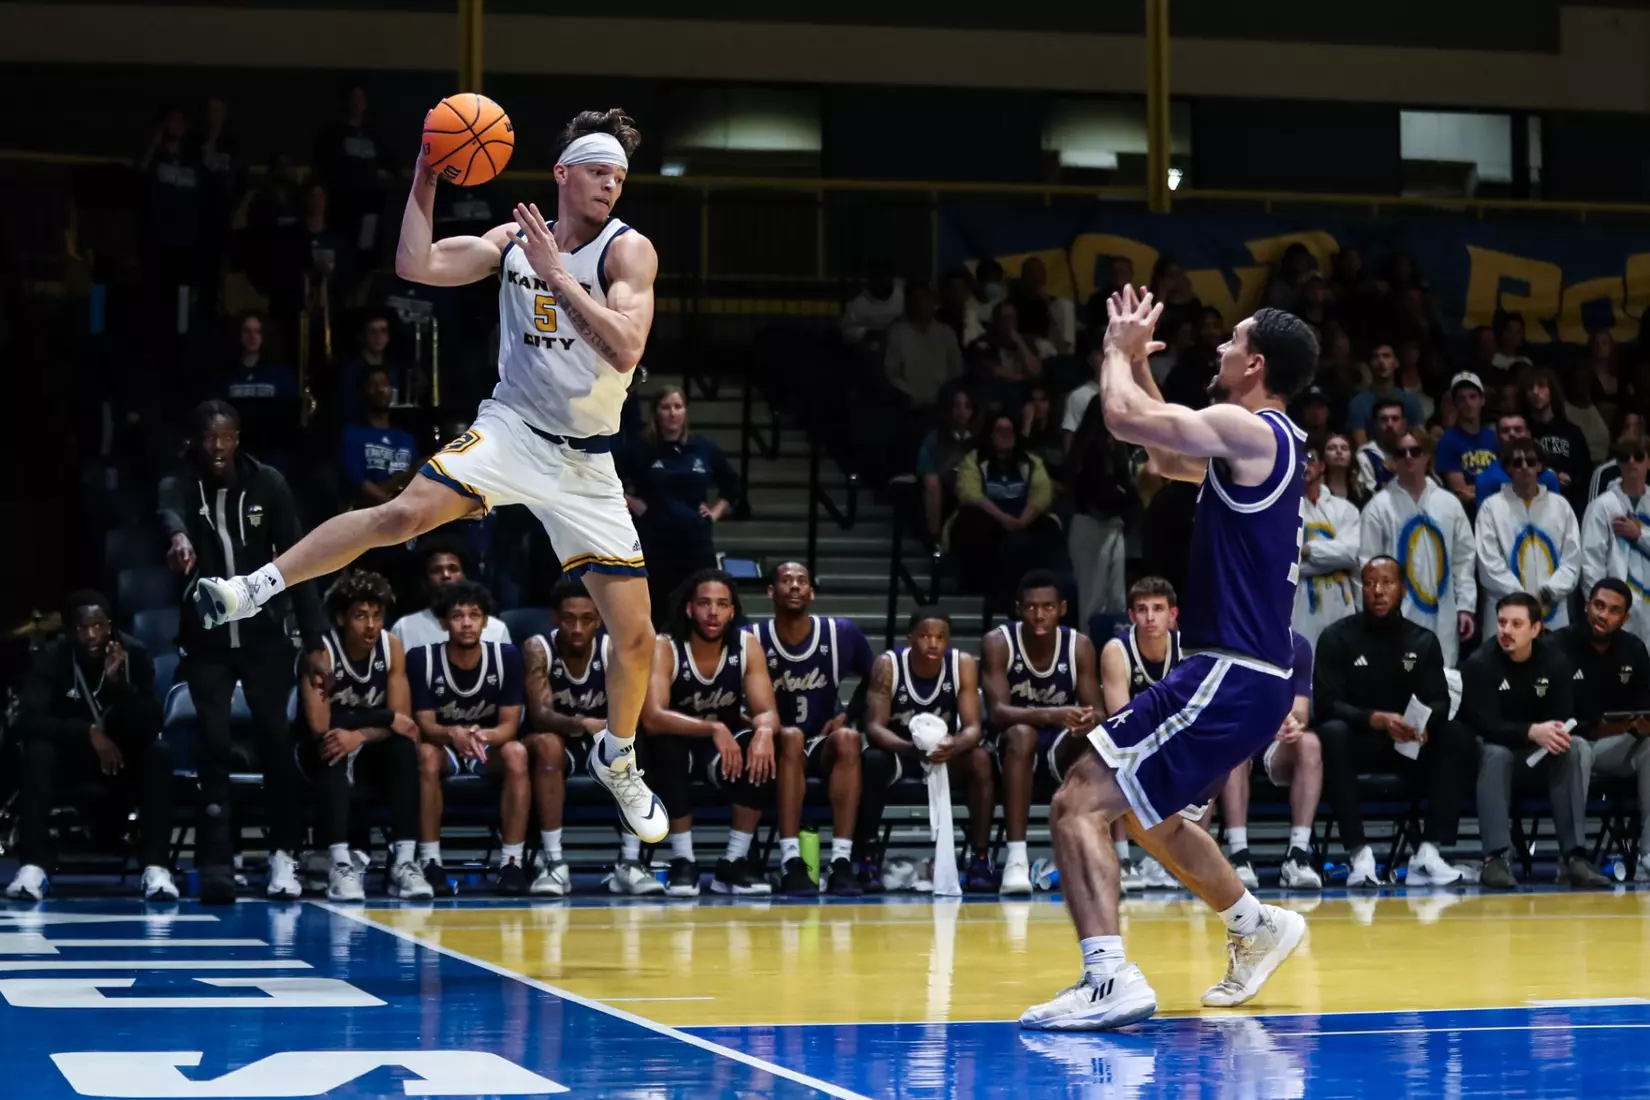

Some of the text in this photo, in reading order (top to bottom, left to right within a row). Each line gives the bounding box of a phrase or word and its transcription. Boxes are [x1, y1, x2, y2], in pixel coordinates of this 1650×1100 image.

[507, 270, 592, 296] KANS
[534, 294, 558, 333] 5
[524, 332, 576, 351] CITY
[795, 695, 809, 724] 3
